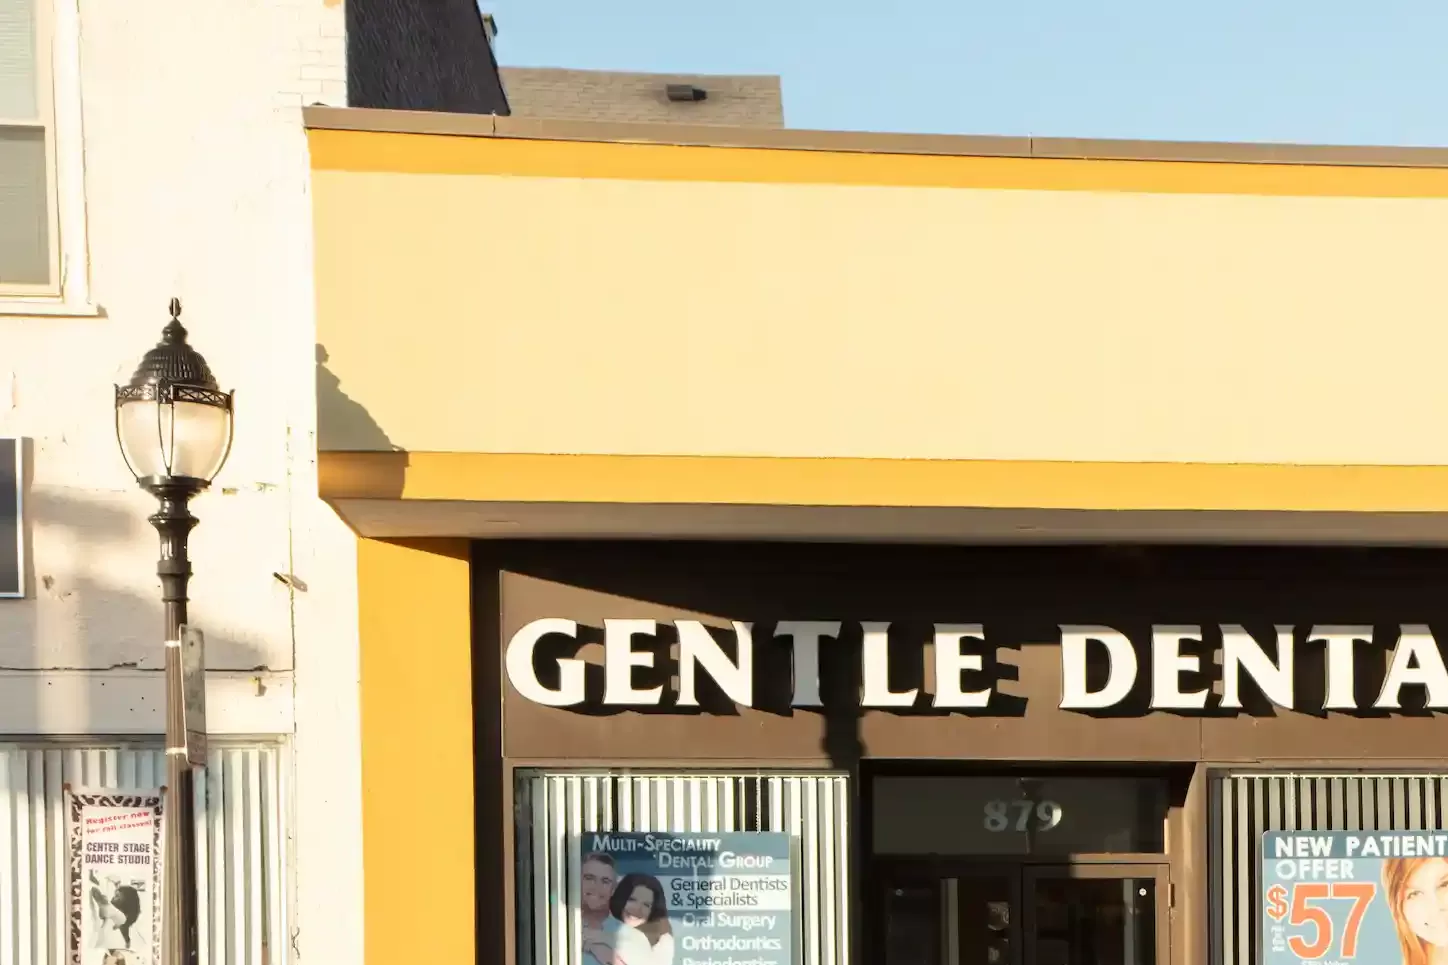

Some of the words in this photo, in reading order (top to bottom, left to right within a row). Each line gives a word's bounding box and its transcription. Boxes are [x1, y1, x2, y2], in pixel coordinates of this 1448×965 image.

[505, 617, 992, 708] GENTLE
[983, 800, 1063, 832] 879
[86, 842, 119, 852] CENTER
[123, 843, 150, 853] STAGE
[1275, 836, 1333, 857] NEW
[1346, 835, 1448, 857] PATIENT
[85, 854, 114, 864] DANCE
[117, 855, 150, 865] STUDIO
[659, 851, 714, 868] DENTAL
[718, 851, 773, 868] GROUP
[1275, 859, 1354, 880] OFFER
[671, 878, 726, 891] General
[730, 876, 788, 891] Dentists
[671, 893, 684, 906] &
[687, 892, 759, 908] Specialists
[682, 912, 715, 928] Oral
[717, 911, 776, 931] Surgery
[1266, 882, 1377, 960] $57
[682, 935, 782, 951] Orthodontics
